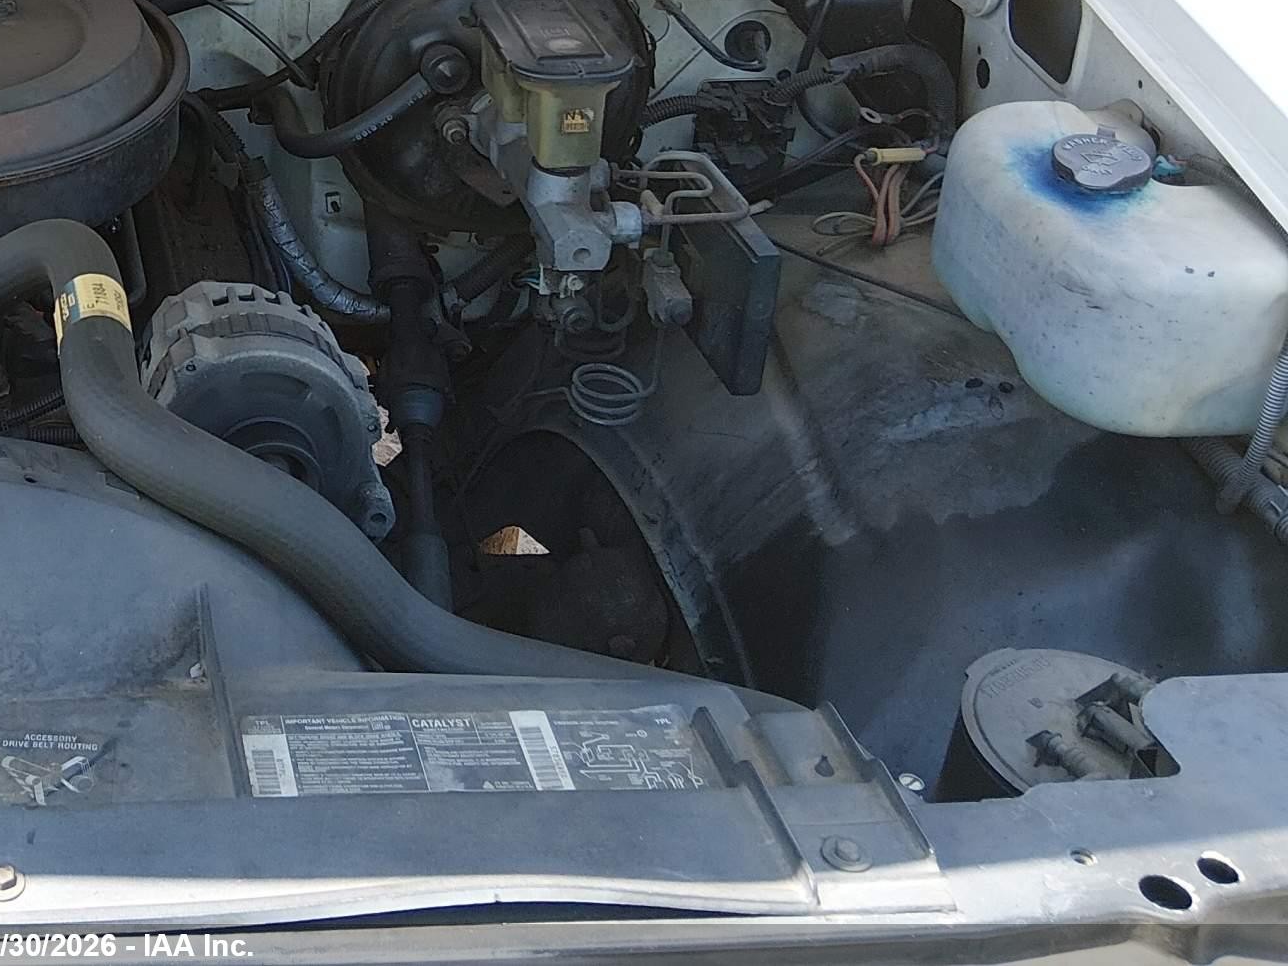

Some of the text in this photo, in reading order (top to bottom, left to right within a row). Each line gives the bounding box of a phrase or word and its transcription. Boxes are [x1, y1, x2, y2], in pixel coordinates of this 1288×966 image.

[411, 718, 472, 729] CATALYST
[655, 717, 672, 725] TPL
[23, 733, 77, 743] ACCESSORY
[2, 739, 99, 751] DRIVE BELT ROUTING
